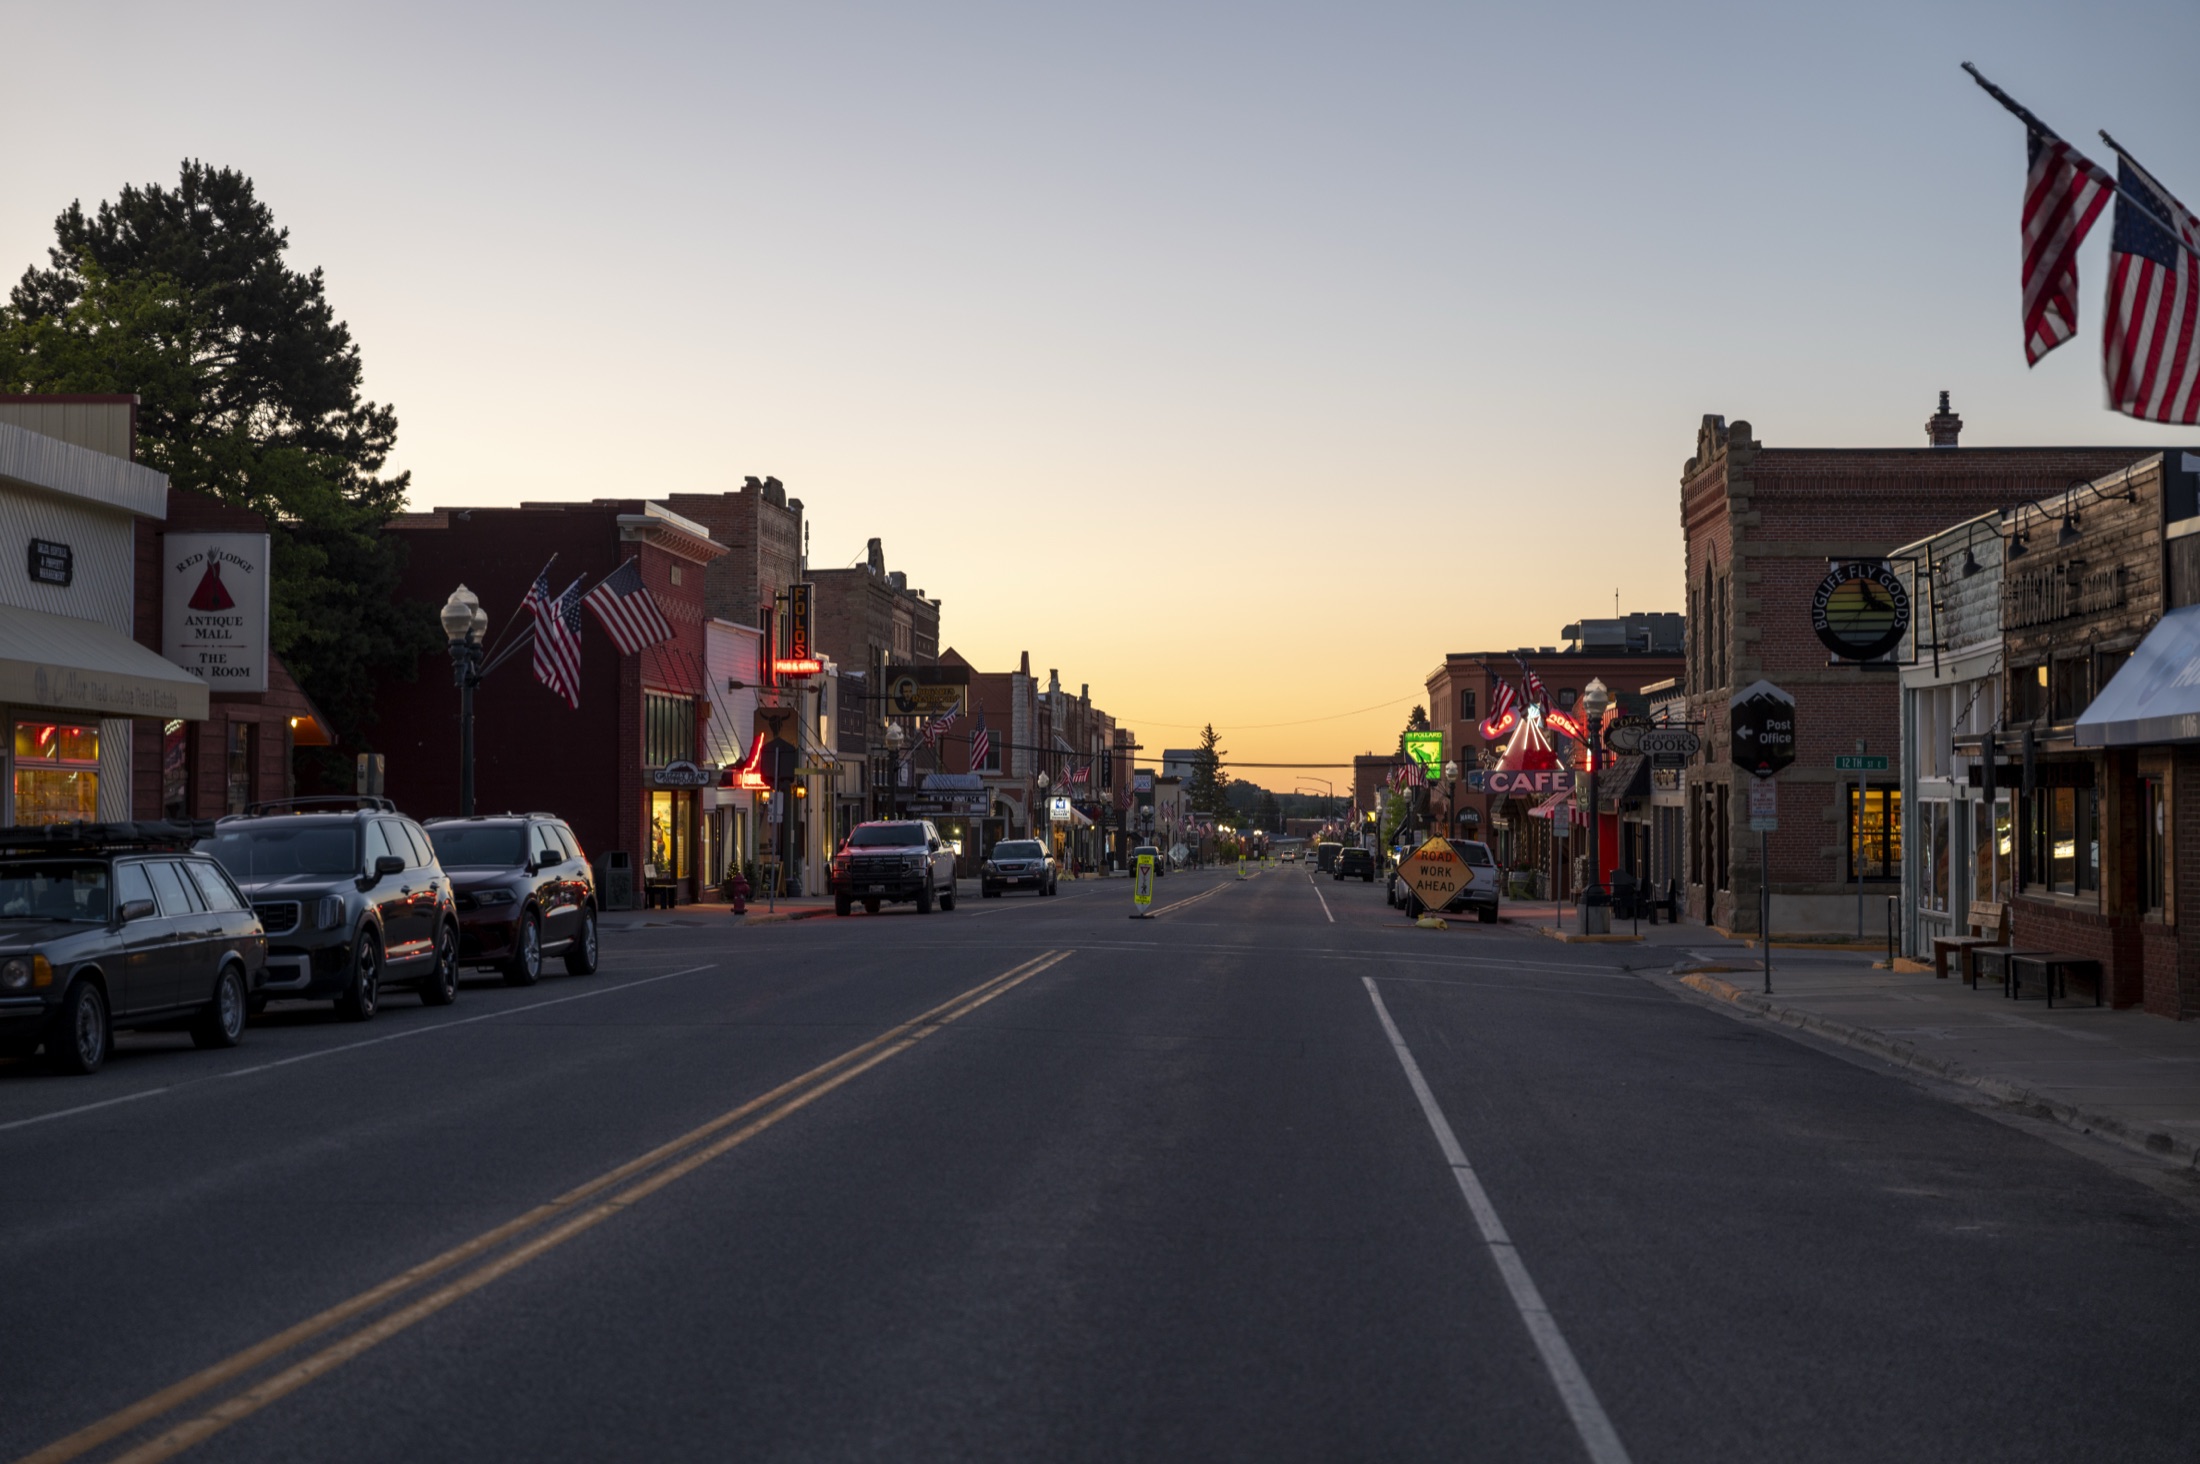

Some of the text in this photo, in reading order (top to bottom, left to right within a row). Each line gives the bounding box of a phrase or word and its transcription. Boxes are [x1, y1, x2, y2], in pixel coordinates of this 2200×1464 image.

[176, 552, 254, 574] RED LODGE
[1813, 565, 1909, 631] BUGLIFE FLY GOODS
[185, 615, 243, 628] ANTIQUE
[794, 587, 806, 659] FOLOS
[195, 628, 233, 640] MALL
[199, 653, 227, 664] THE
[179, 666, 250, 678] UN ROOM
[153, 689, 178, 711] Estate
[1766, 719, 1792, 730] Post
[2181, 714, 2198, 737] 106
[1759, 732, 1792, 744] Office
[1643, 740, 1696, 751] BOOKS
[1489, 772, 1569, 792] CAFE
[1421, 850, 1453, 862] ROAD
[1420, 865, 1452, 878] WORK
[1416, 880, 1455, 893] AHEAD
